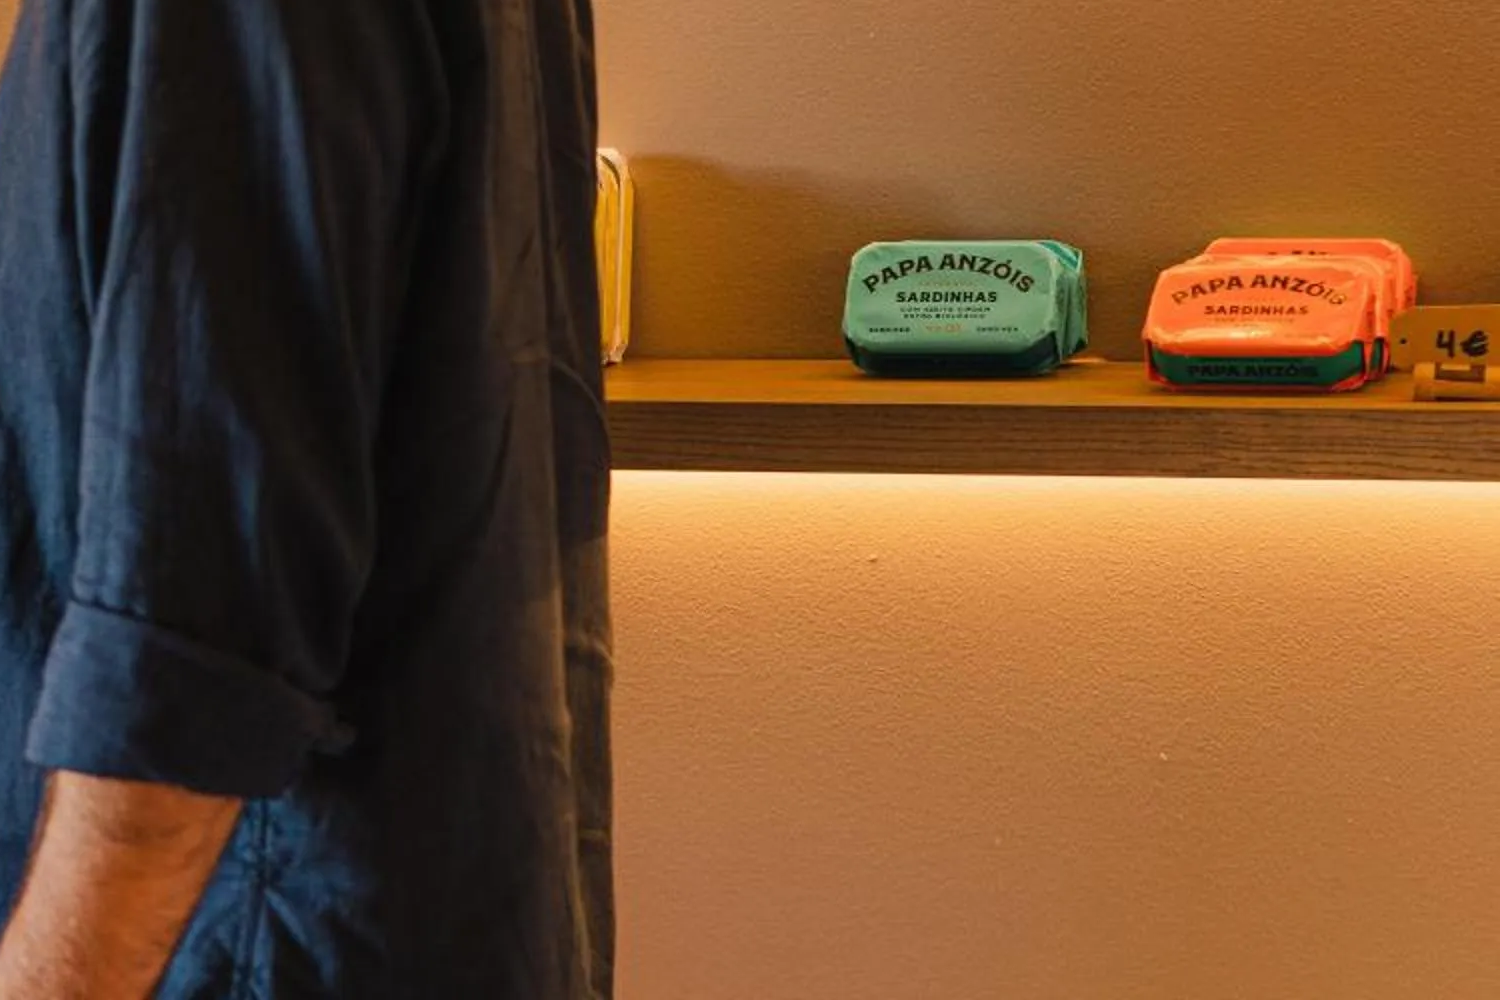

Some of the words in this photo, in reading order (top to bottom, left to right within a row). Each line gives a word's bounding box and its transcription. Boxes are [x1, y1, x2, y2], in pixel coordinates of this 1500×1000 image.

[862, 255, 933, 294] PAPA
[939, 253, 1036, 293] ANZÓIS
[895, 291, 998, 303] SARDINHAS
[1171, 275, 1244, 304] PAPA
[1249, 274, 1348, 305] ANZÓIS
[1204, 305, 1310, 316] SARDINHAS
[1436, 329, 1489, 359] 4€
